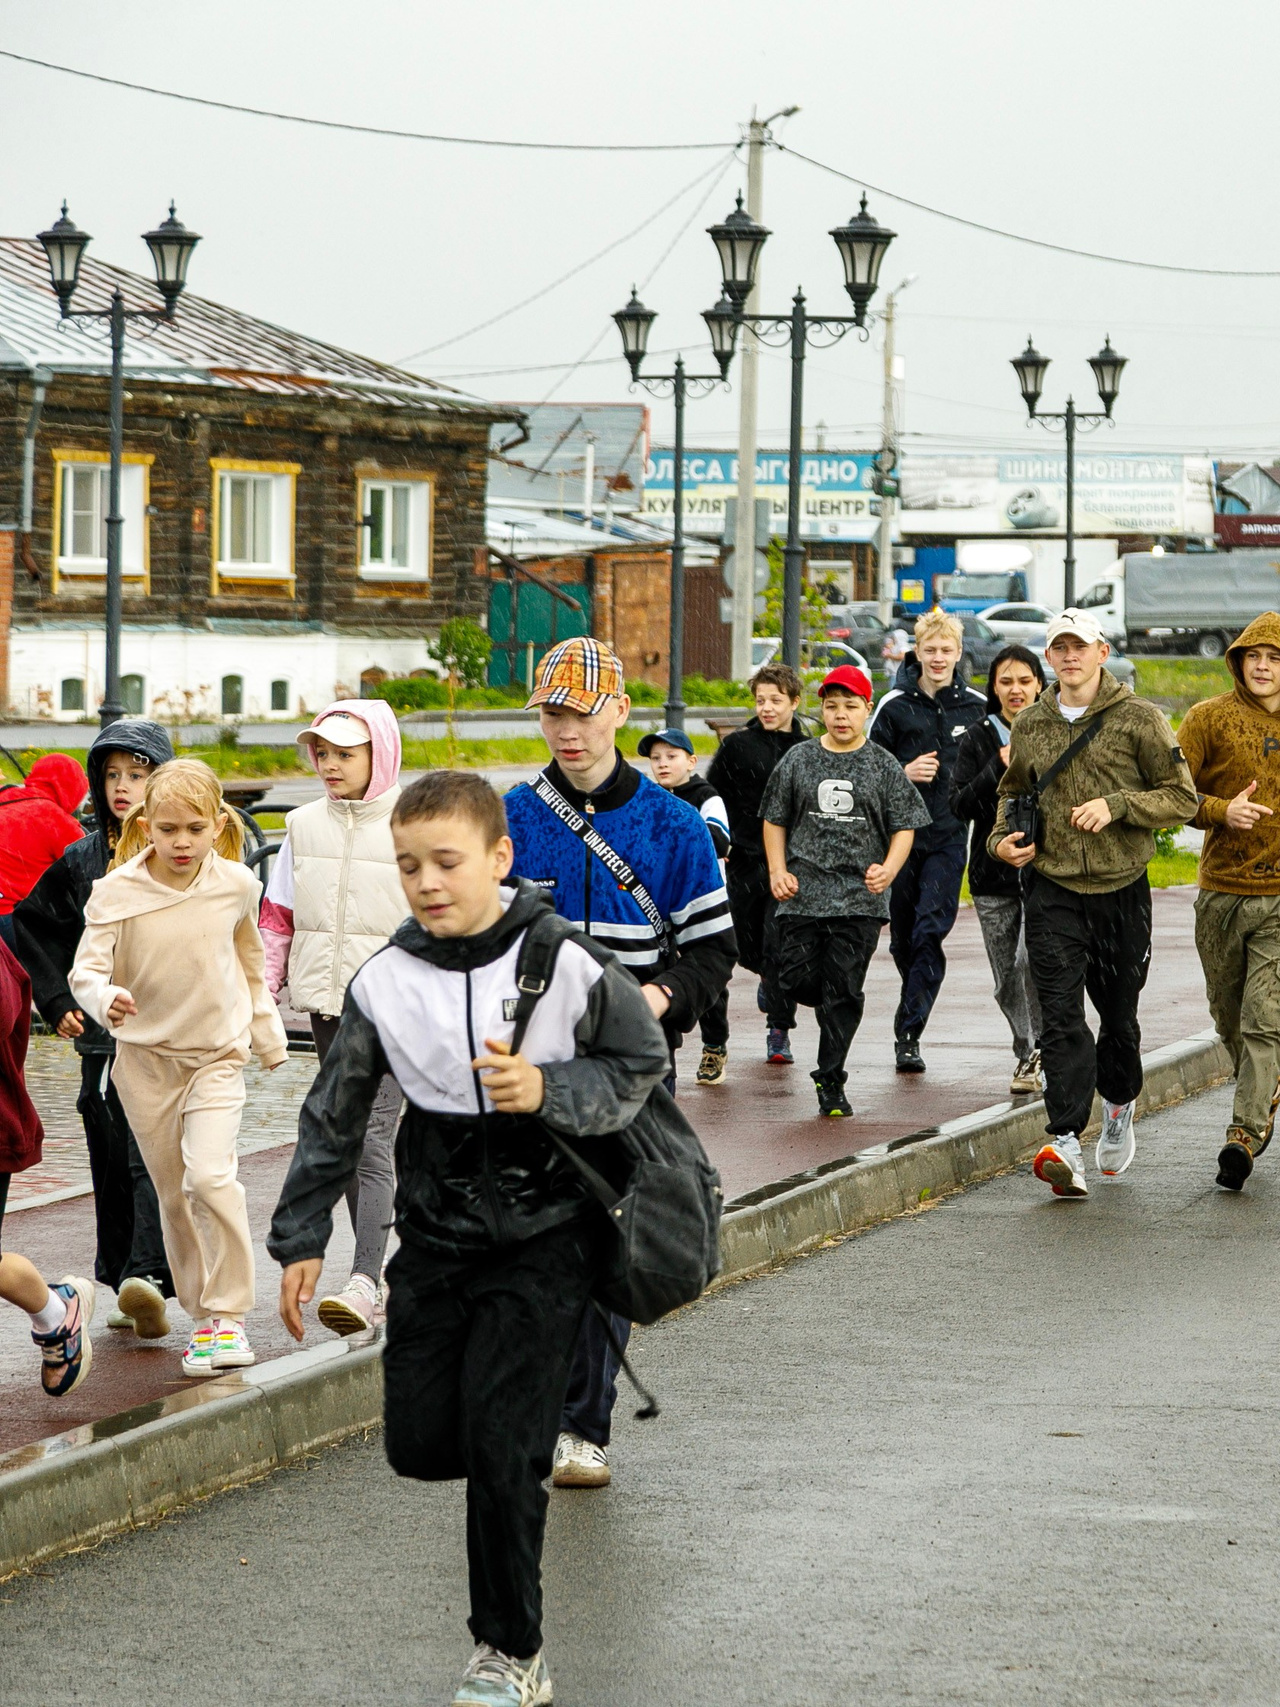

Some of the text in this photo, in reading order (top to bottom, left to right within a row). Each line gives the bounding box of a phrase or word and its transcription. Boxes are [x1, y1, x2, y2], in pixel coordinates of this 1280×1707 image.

[645, 458, 724, 482] ОЛЕСА
[806, 500, 865, 516] ЦЕНТР
[818, 779, 854, 813] 6
[535, 781, 585, 831] UNAFFECTED
[631, 883, 664, 935] UNAFFECTED
